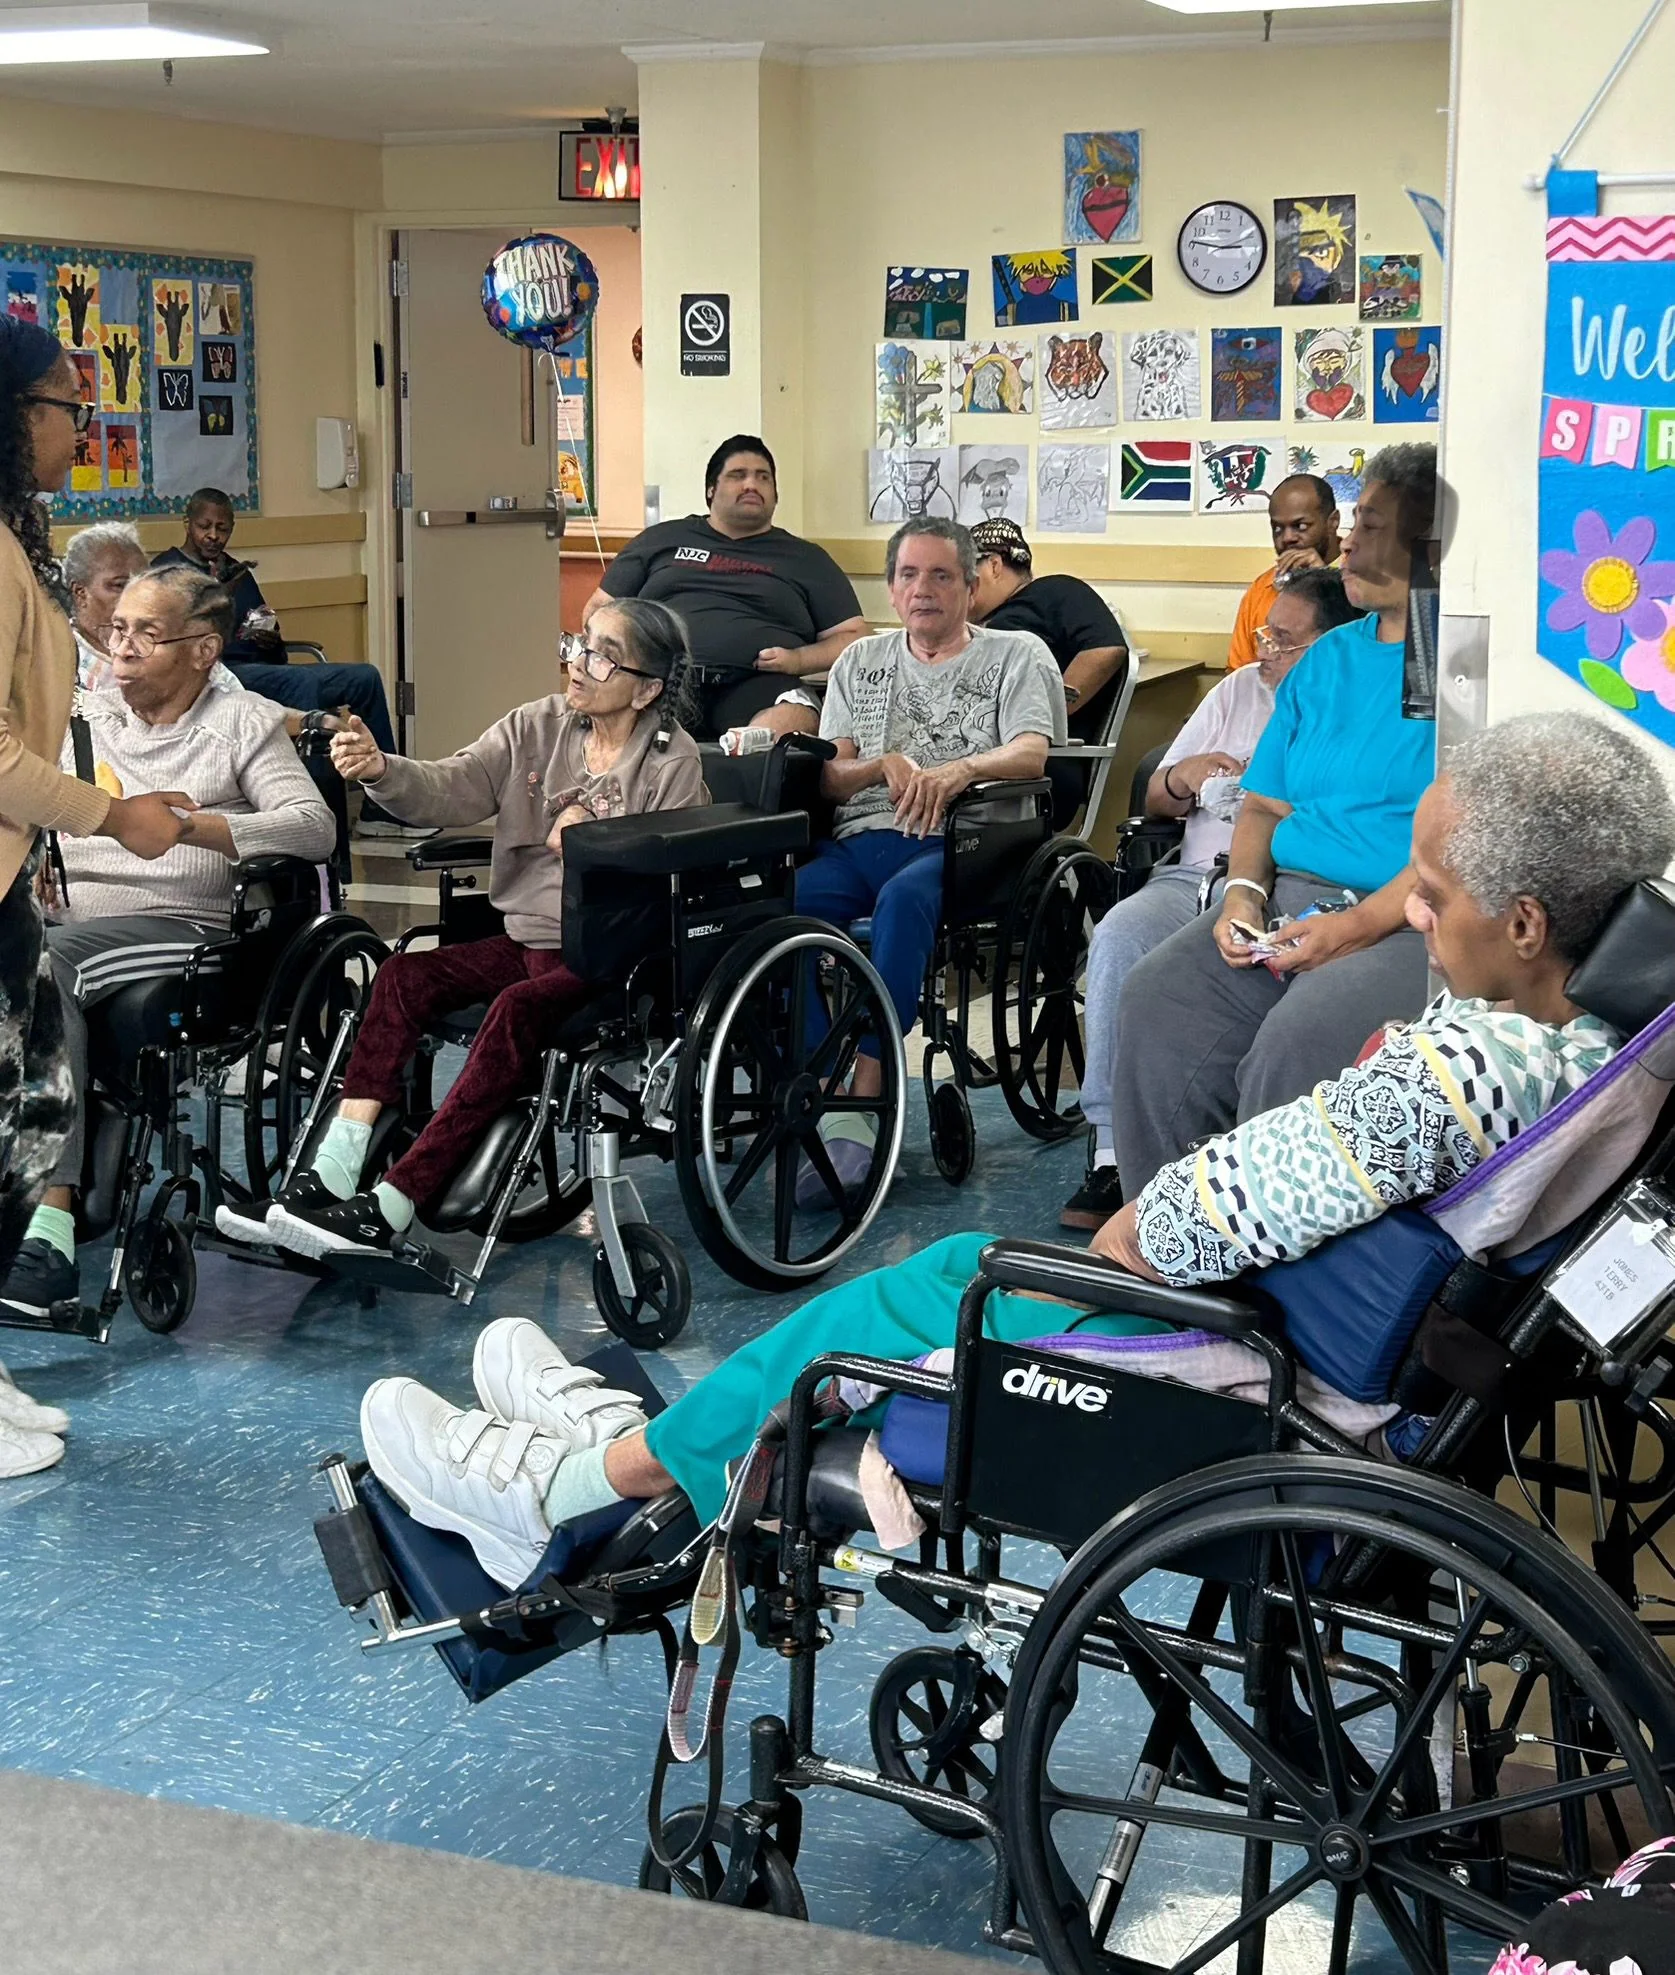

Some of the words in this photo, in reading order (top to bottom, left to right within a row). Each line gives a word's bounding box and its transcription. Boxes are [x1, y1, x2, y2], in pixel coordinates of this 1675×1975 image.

[492, 242, 575, 281] THANK
[509, 277, 573, 327] YOU!
[1571, 295, 1675, 382] Wel
[683, 354, 694, 362] NO
[677, 548, 707, 562] NJC
[1603, 1265, 1628, 1292] TERRY
[1612, 1258, 1640, 1283] JONES
[1002, 1363, 1108, 1413] drive
